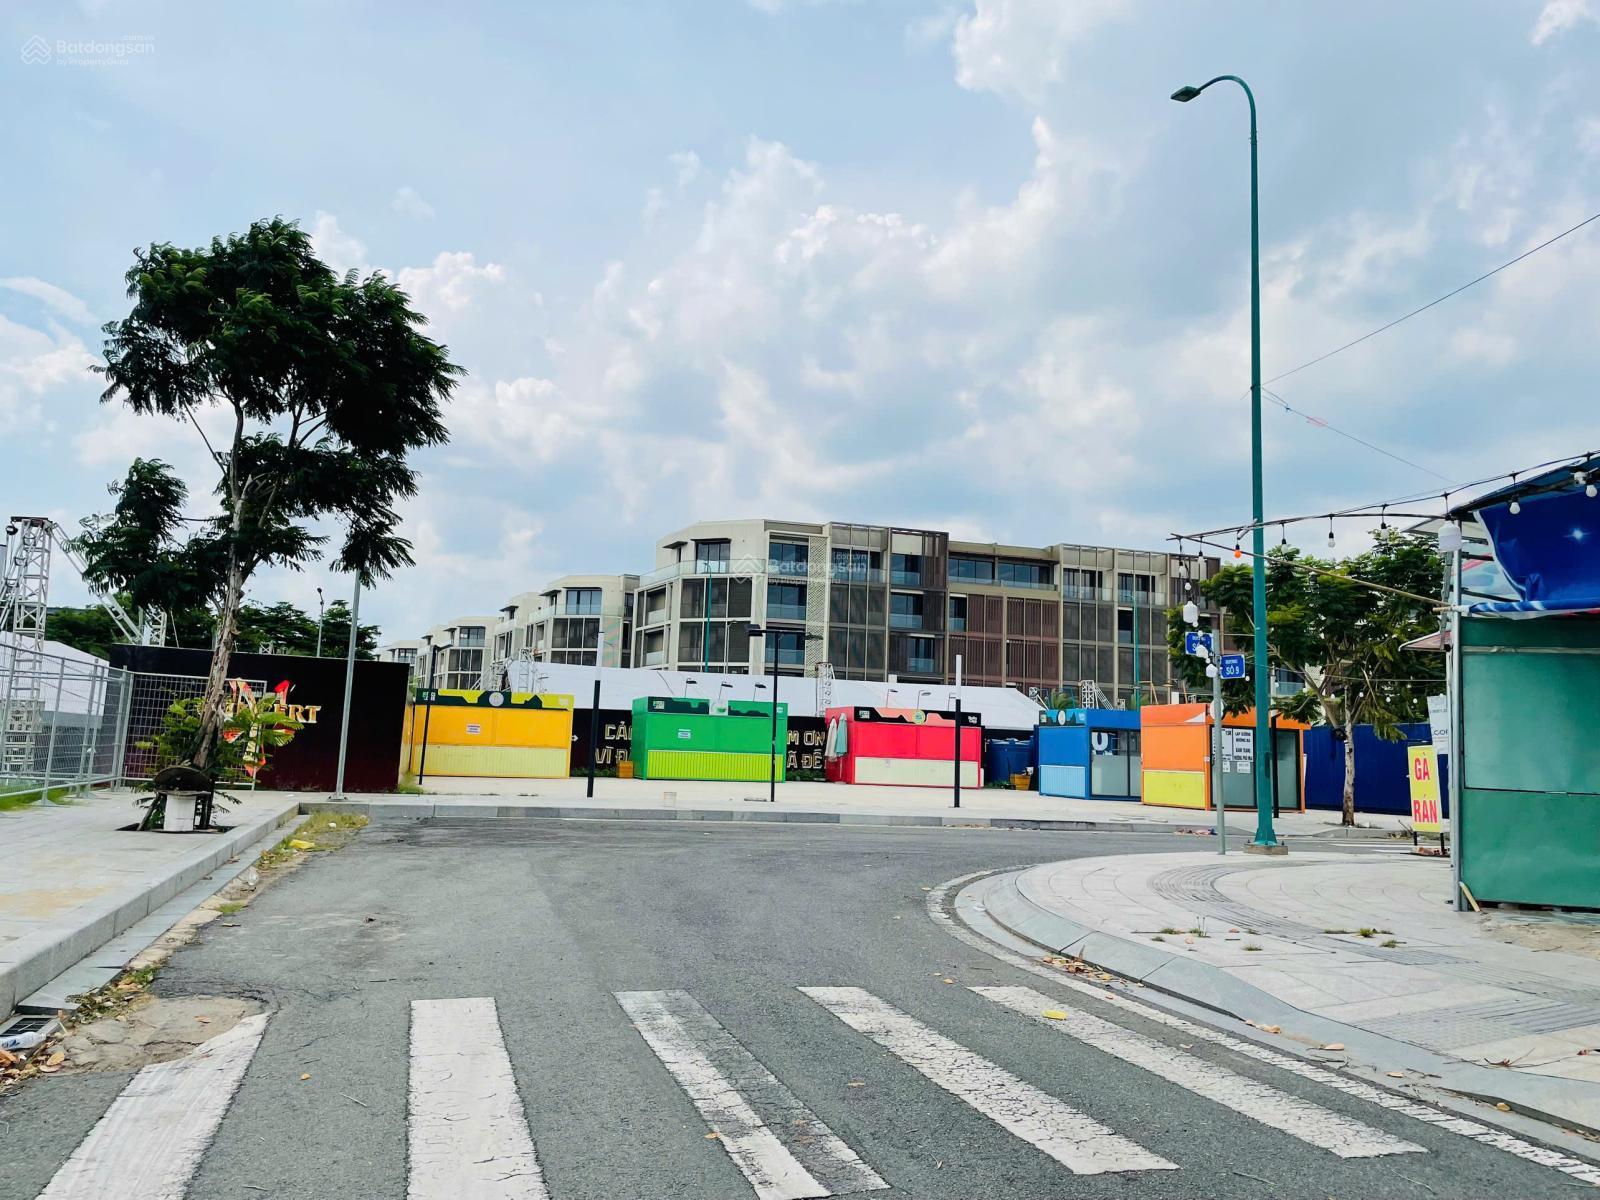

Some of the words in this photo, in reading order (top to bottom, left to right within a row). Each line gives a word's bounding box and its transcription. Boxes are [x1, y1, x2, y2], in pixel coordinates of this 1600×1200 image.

[615, 747, 632, 764] Đ
[786, 750, 798, 769] Ã
[801, 748, 827, 769] ĐẾ
[1414, 752, 1431, 781] GÀ
[1413, 794, 1438, 824] RÁN
